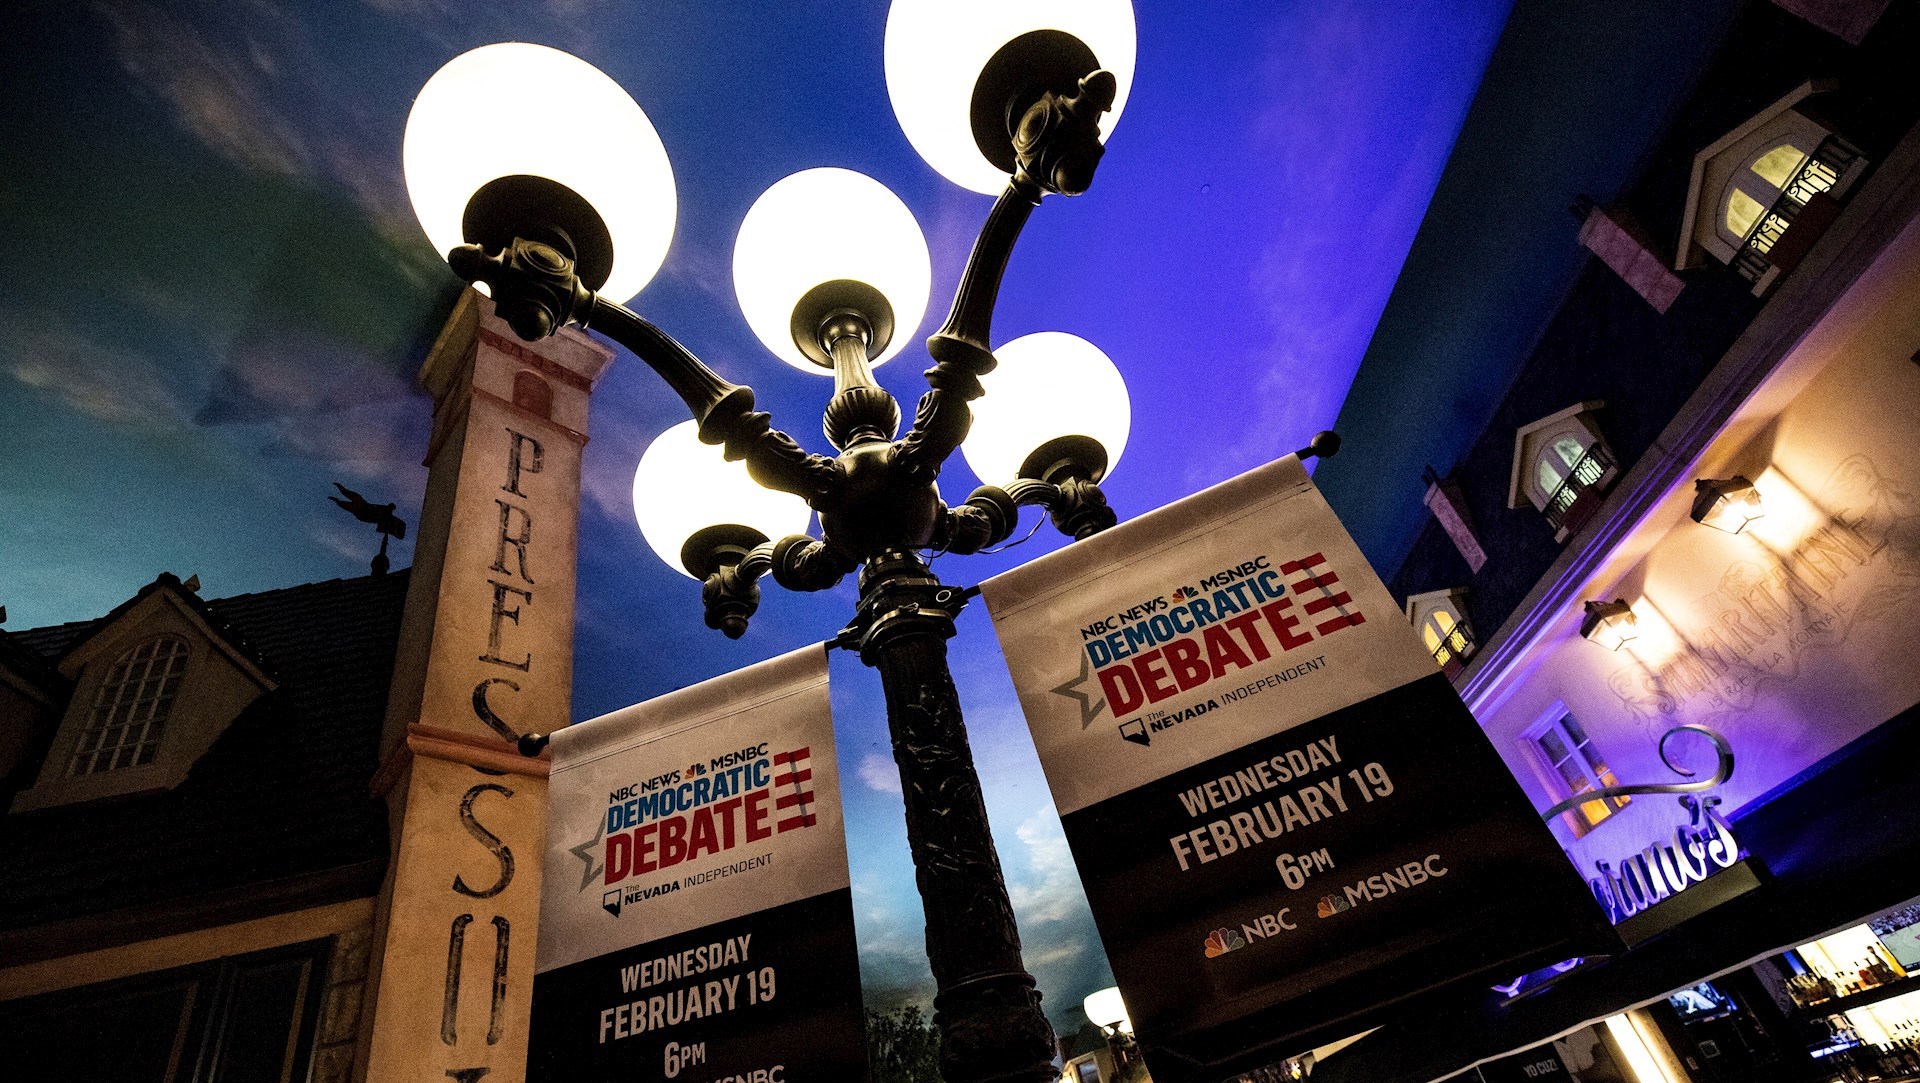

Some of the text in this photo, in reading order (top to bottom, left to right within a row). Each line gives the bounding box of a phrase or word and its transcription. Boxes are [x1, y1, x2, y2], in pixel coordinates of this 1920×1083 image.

[1081, 555, 1271, 641] NBC NEWS MSNBC
[1085, 570, 1286, 669] DEMOCRATIC
[1097, 596, 1314, 719] DEBATE
[1149, 655, 1327, 734] NEVADA INDEPENDENT
[1147, 708, 1165, 722] The
[606, 758, 770, 835] DEMOCRATIC
[609, 742, 769, 805] NBC NEWS MSNBC
[1178, 735, 1343, 818] WEDNESDAY
[604, 791, 772, 886] DEBATE
[1169, 761, 1395, 872] FEBRUARY 19
[624, 853, 773, 906] NEVADA INDEPENDENT
[625, 883, 640, 893] The
[1242, 853, 1448, 944] NBC MSNBC
[1275, 847, 1336, 890] 6PM
[620, 933, 752, 994] WEDNESDAY
[599, 966, 776, 1044] FEBRUARY 19
[664, 1041, 706, 1079] 6PM
